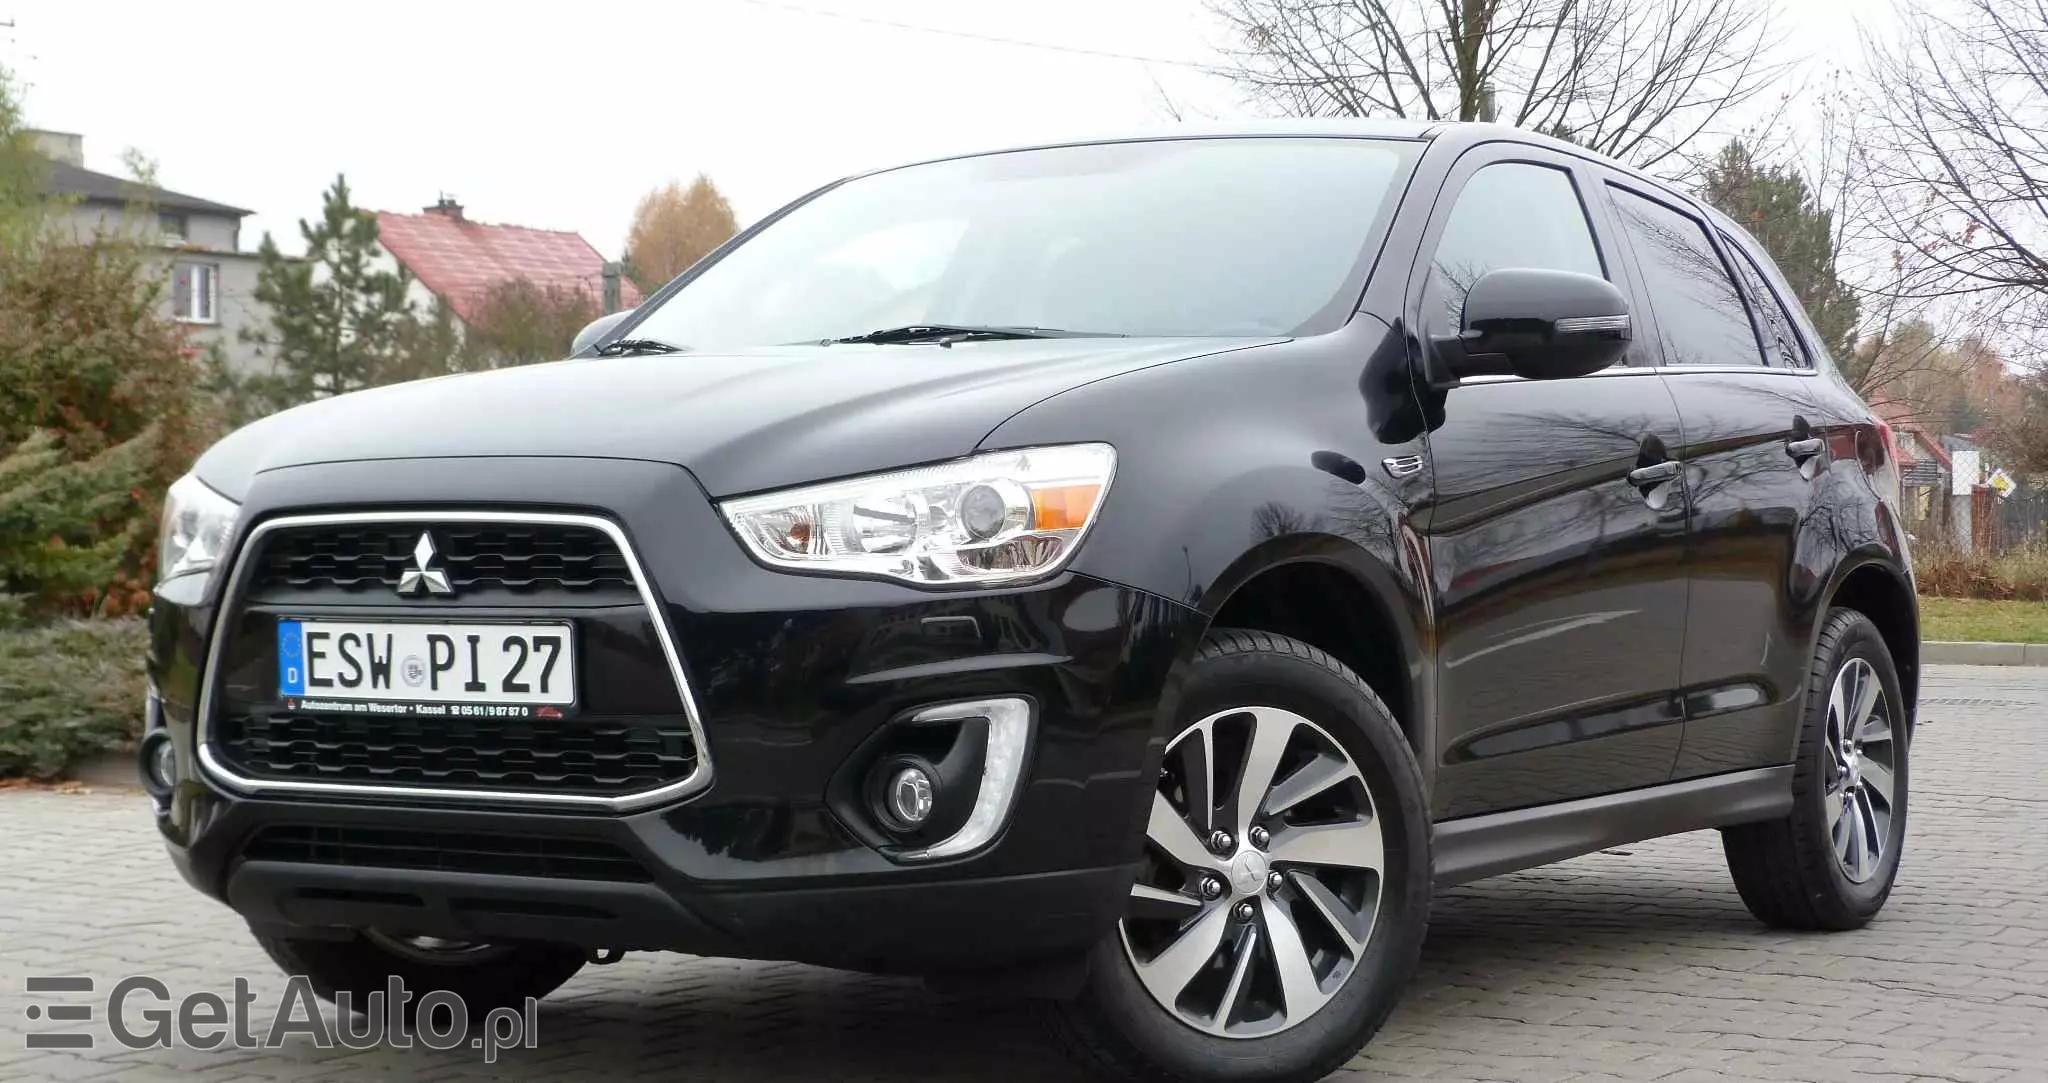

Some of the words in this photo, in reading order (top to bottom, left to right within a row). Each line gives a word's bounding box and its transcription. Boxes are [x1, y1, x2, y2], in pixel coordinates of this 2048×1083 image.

[306, 631, 393, 690] ESW
[426, 633, 487, 692] PI
[502, 635, 562, 694] 27
[287, 667, 299, 683] D
[416, 704, 446, 714] Kassel
